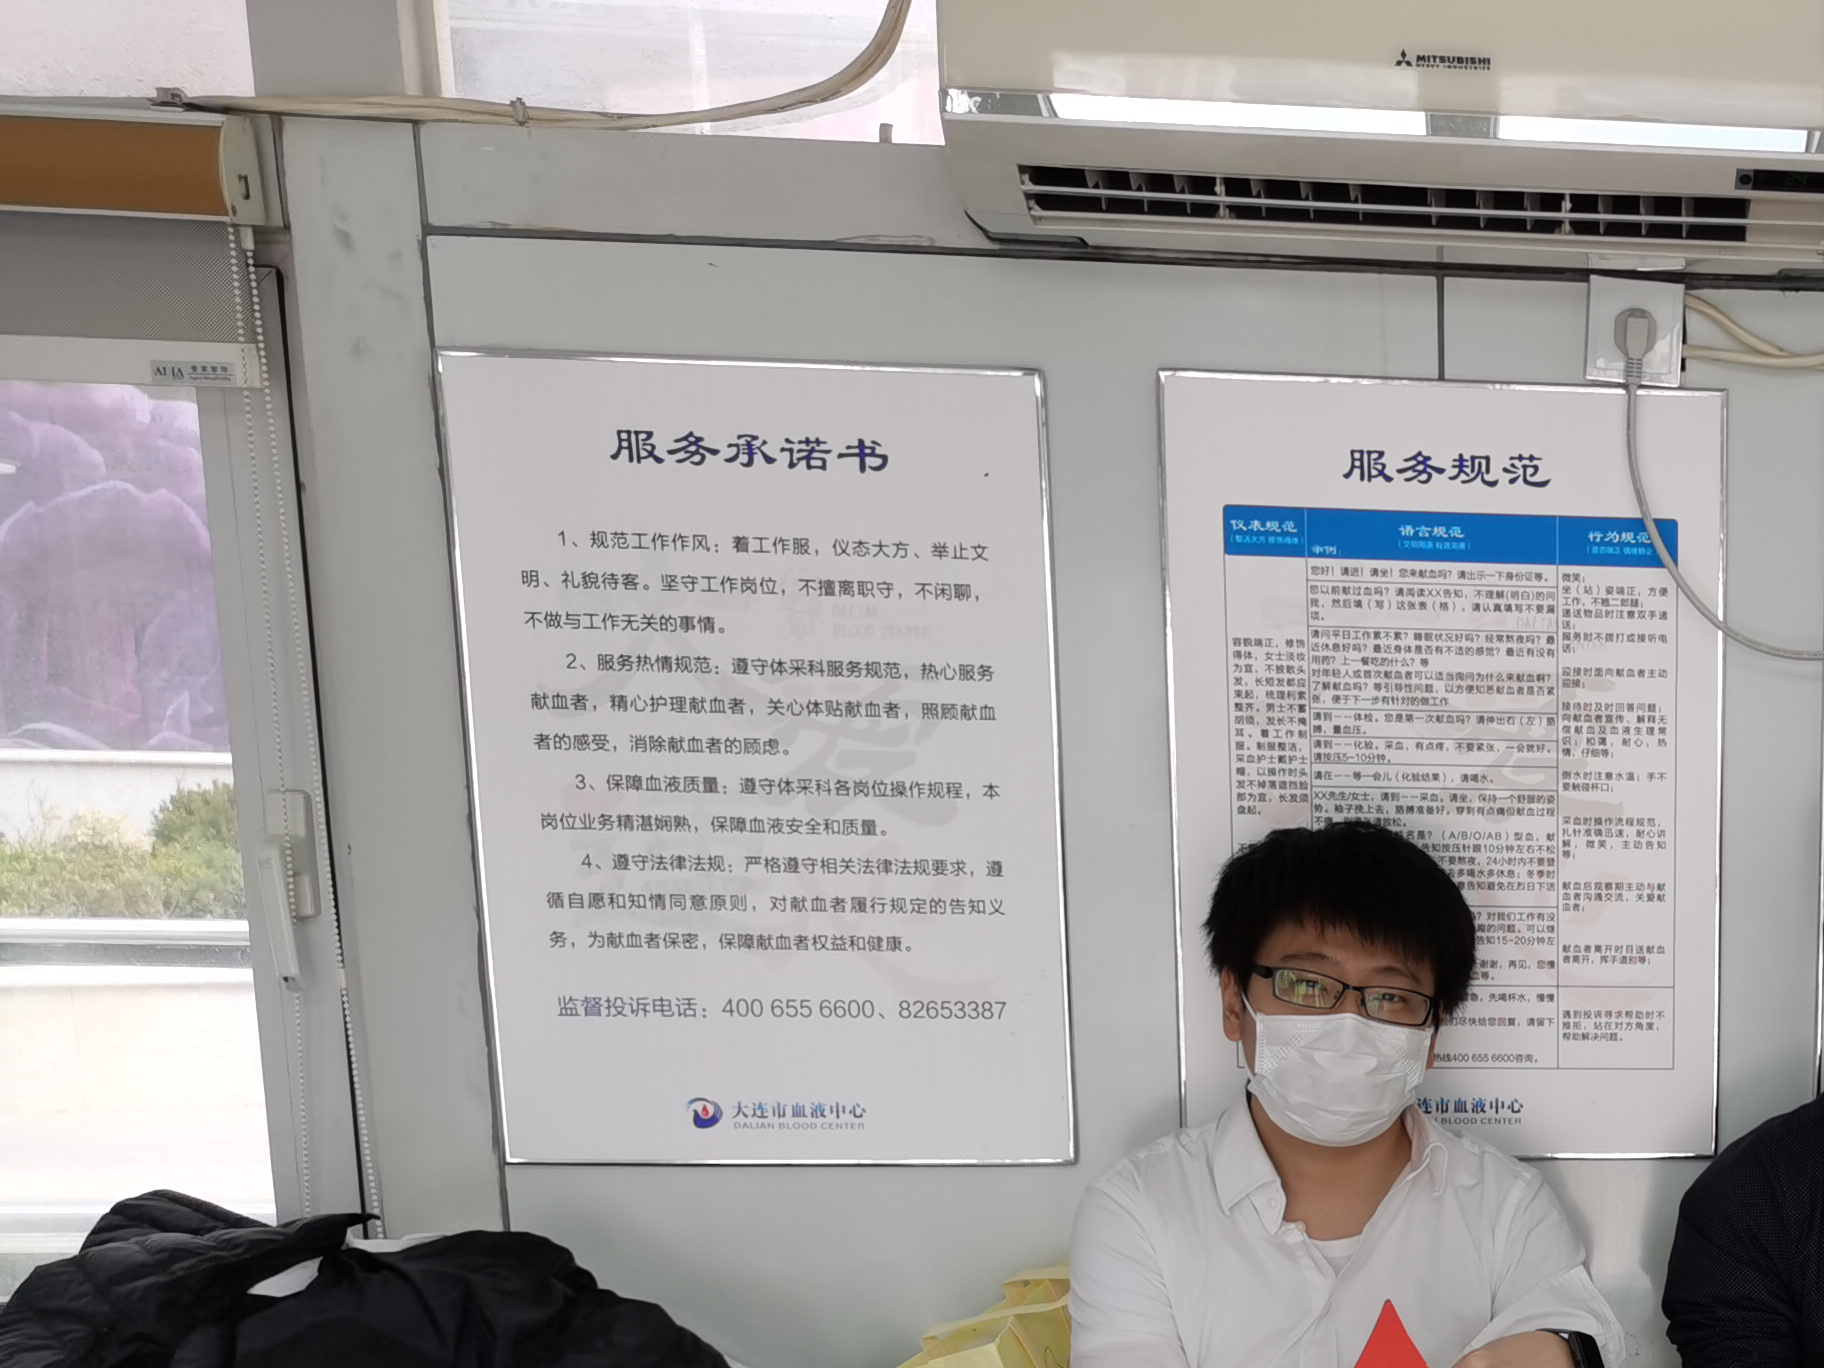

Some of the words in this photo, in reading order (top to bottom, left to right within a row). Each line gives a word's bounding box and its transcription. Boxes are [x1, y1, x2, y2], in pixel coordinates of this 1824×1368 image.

[1415, 54, 1491, 66] MITSUBISHI
[609, 428, 890, 474] 服务承诺书
[1342, 449, 1552, 488] 服务规范
[770, 999, 813, 1020] 655
